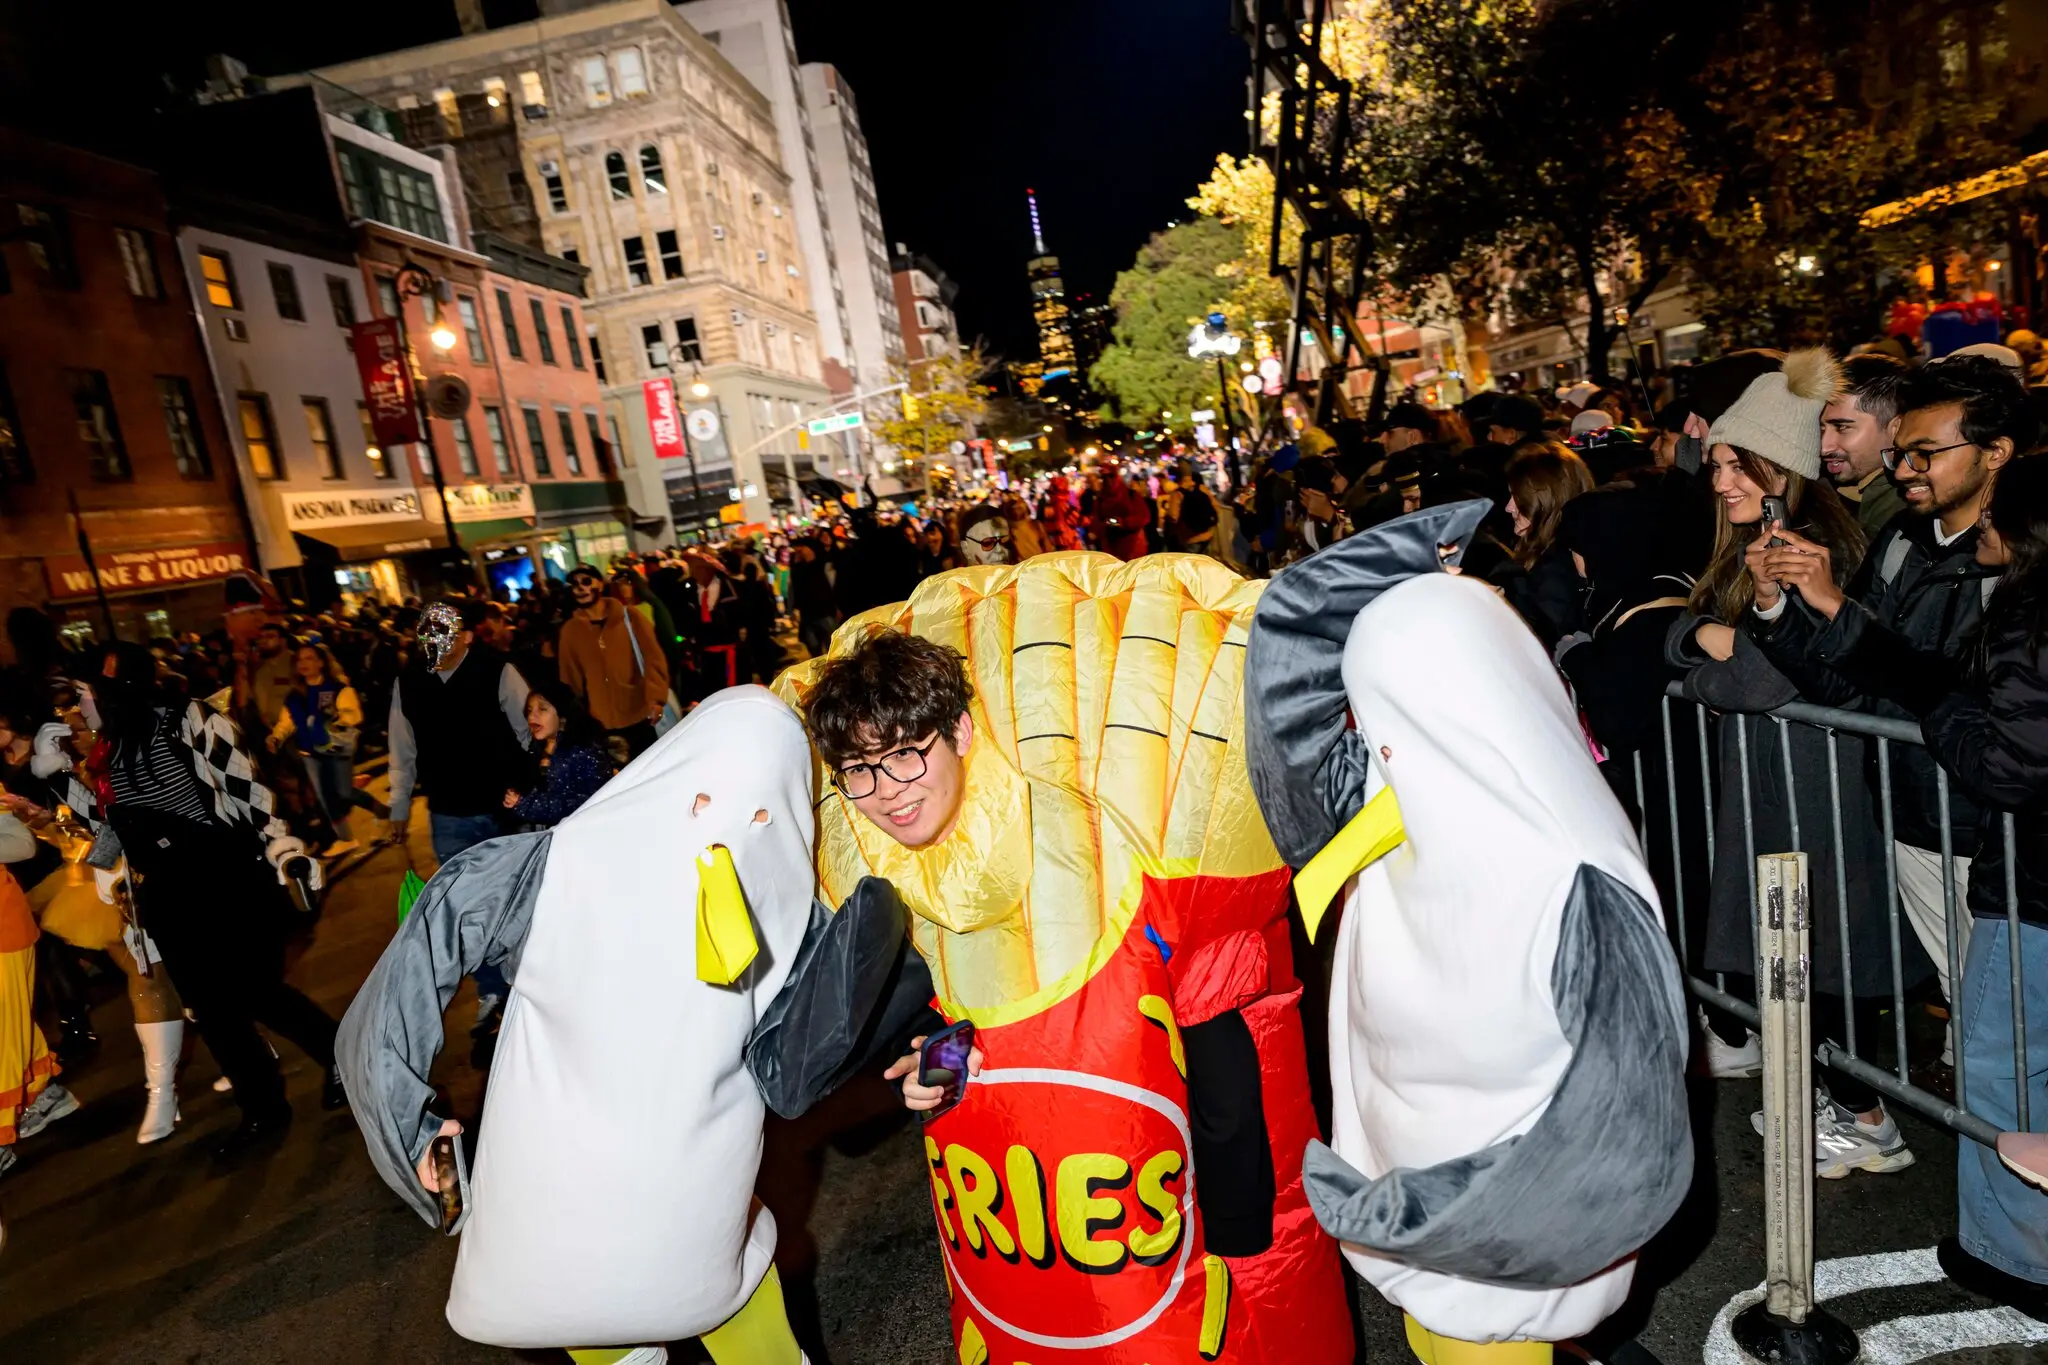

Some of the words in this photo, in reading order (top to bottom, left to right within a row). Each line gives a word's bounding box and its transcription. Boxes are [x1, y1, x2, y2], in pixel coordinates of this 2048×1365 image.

[656, 389, 679, 445] VILLAGE
[292, 500, 347, 521] ANSONIA
[349, 494, 418, 516] PHARMA
[137, 564, 156, 582] &
[158, 554, 243, 580] LIQUOR
[1774, 1171, 1782, 1189] TACOMA
[924, 1135, 1187, 1274] FRIES
